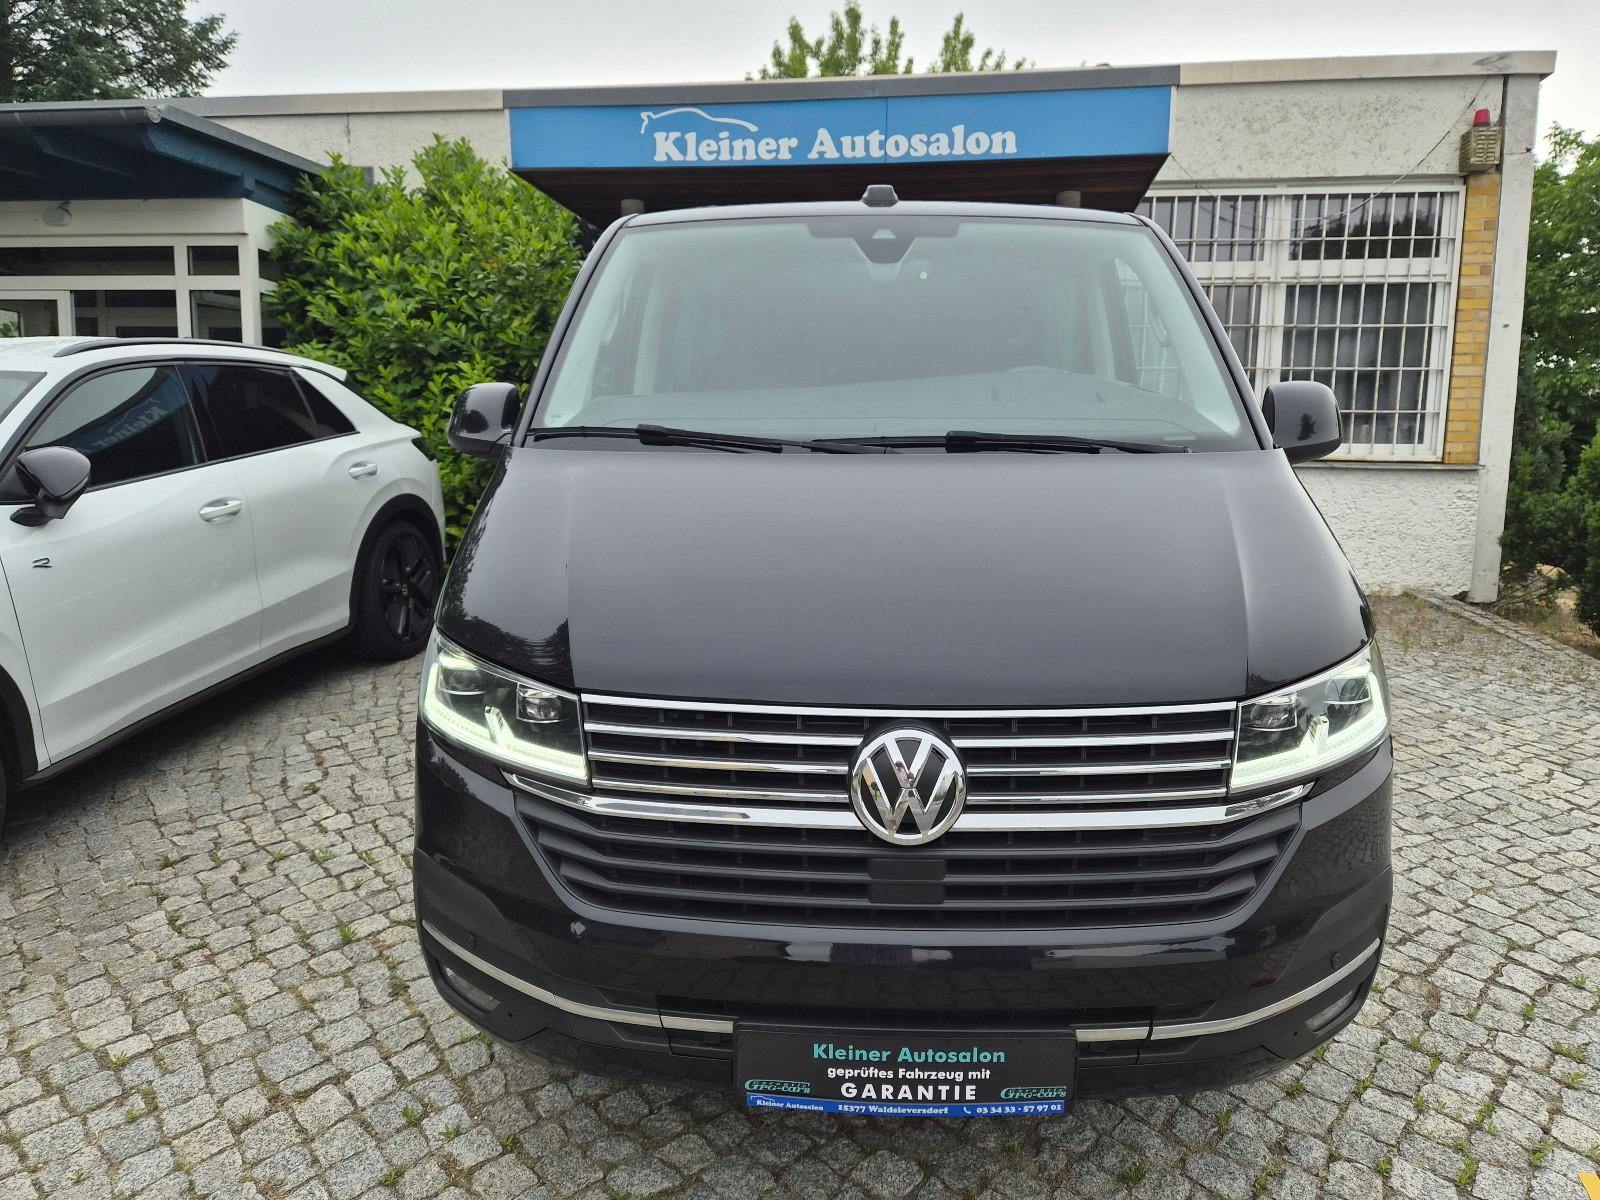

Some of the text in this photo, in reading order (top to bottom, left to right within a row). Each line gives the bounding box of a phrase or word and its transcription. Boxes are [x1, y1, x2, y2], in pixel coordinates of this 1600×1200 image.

[653, 124, 1018, 162] Kleiner Autosalon
[857, 734, 962, 841] VW
[812, 1043, 1006, 1063] Kleiner Autosalon
[827, 1066, 991, 1082] geprüftes Fahrzeug mit
[840, 1082, 977, 1101] GARANTIE
[756, 1099, 824, 1111] Kleiner Autosalon
[838, 1104, 949, 1115] 15377 Waldsieversdorf
[990, 1106, 1003, 1114] 34
[1023, 1105, 1035, 1113] 57
[1036, 1104, 1049, 1112] 97
[1050, 1104, 1062, 1112] 01
